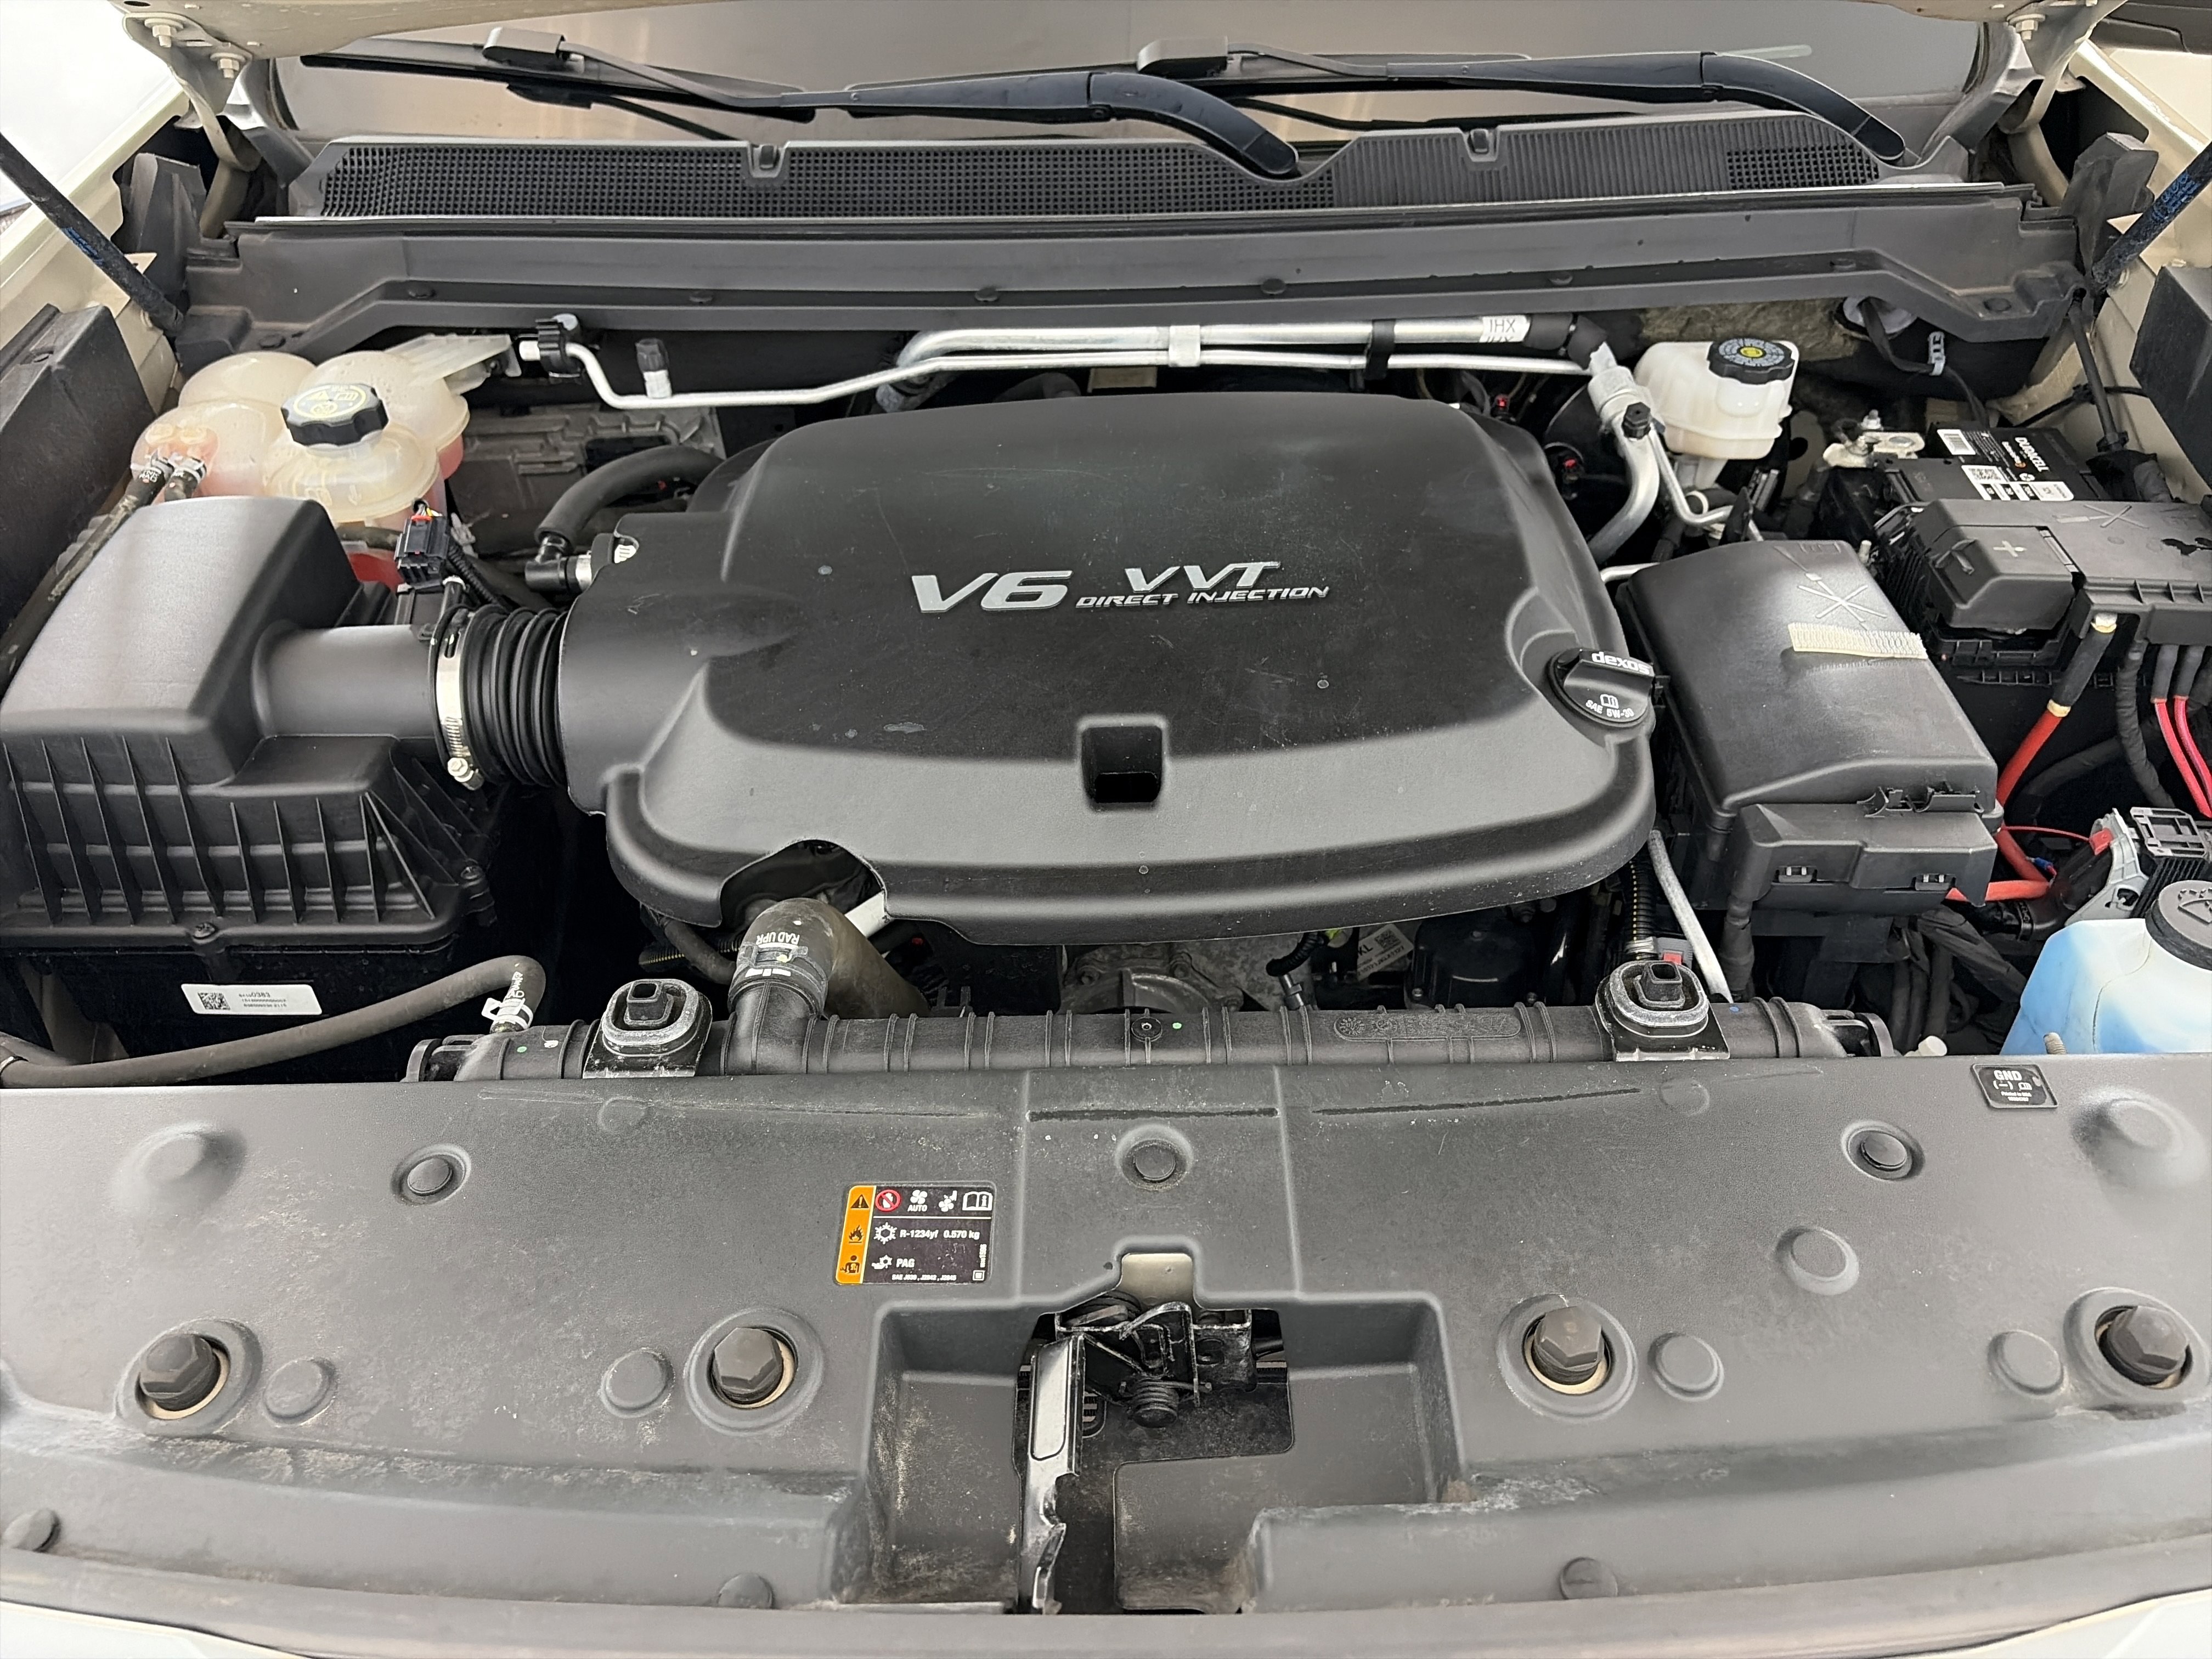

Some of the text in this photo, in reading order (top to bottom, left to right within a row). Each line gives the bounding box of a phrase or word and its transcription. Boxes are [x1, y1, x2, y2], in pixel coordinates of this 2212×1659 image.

[1489, 319, 1515, 333] IHX
[1124, 561, 1281, 594] VVT
[911, 570, 1073, 613] V6
[1076, 585, 1329, 608] DIRECT INJECTION
[1592, 651, 1650, 675] dexos
[1585, 699, 1634, 718] SAE 5W-30
[755, 932, 800, 945] RAD UPR
[1994, 1070, 2022, 1081] GND
[900, 1229, 980, 1240] R-1234yf 0.570 kg
[896, 1258, 915, 1268] PAG
